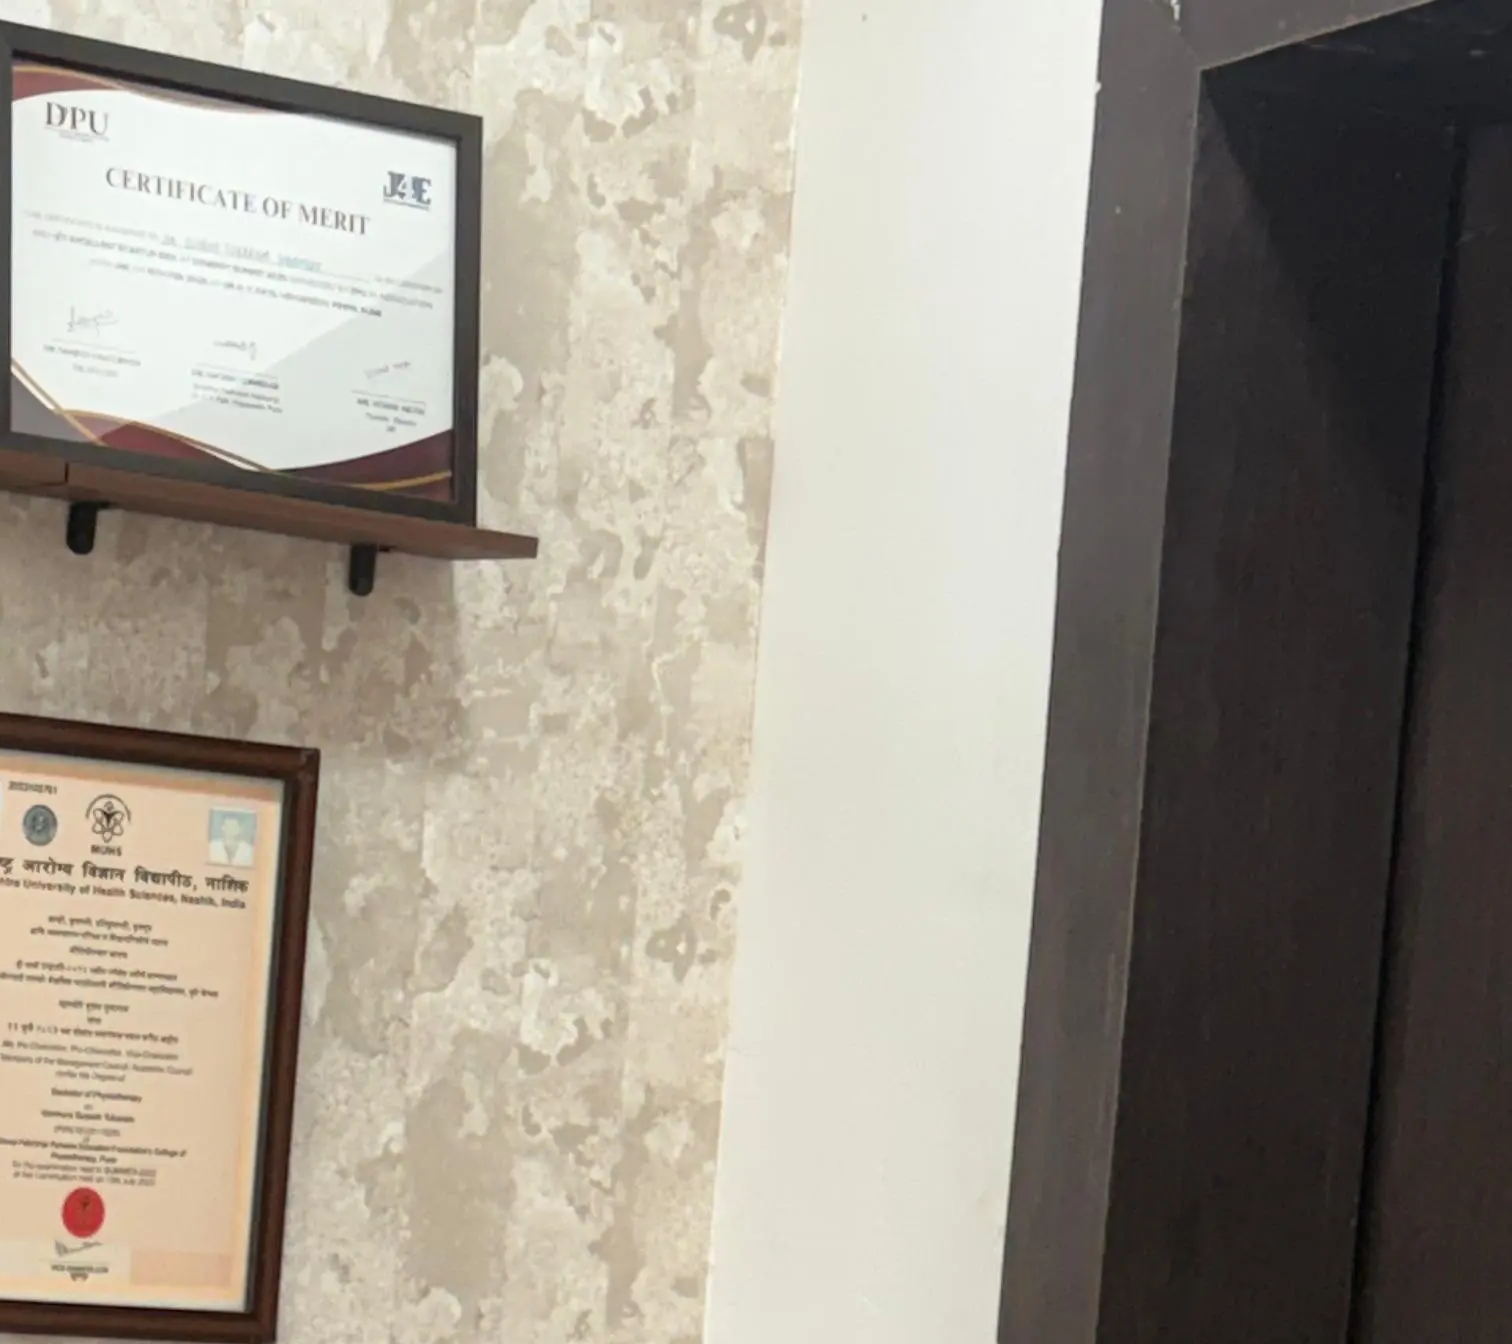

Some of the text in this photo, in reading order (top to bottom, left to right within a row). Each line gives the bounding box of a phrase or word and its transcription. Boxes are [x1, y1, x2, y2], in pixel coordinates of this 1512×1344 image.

[45, 101, 110, 137] DPU
[105, 165, 372, 237] CERTIFICATE OF MERIT
[22, 857, 74, 877] आरोग्य
[81, 861, 126, 882] विज्ञान
